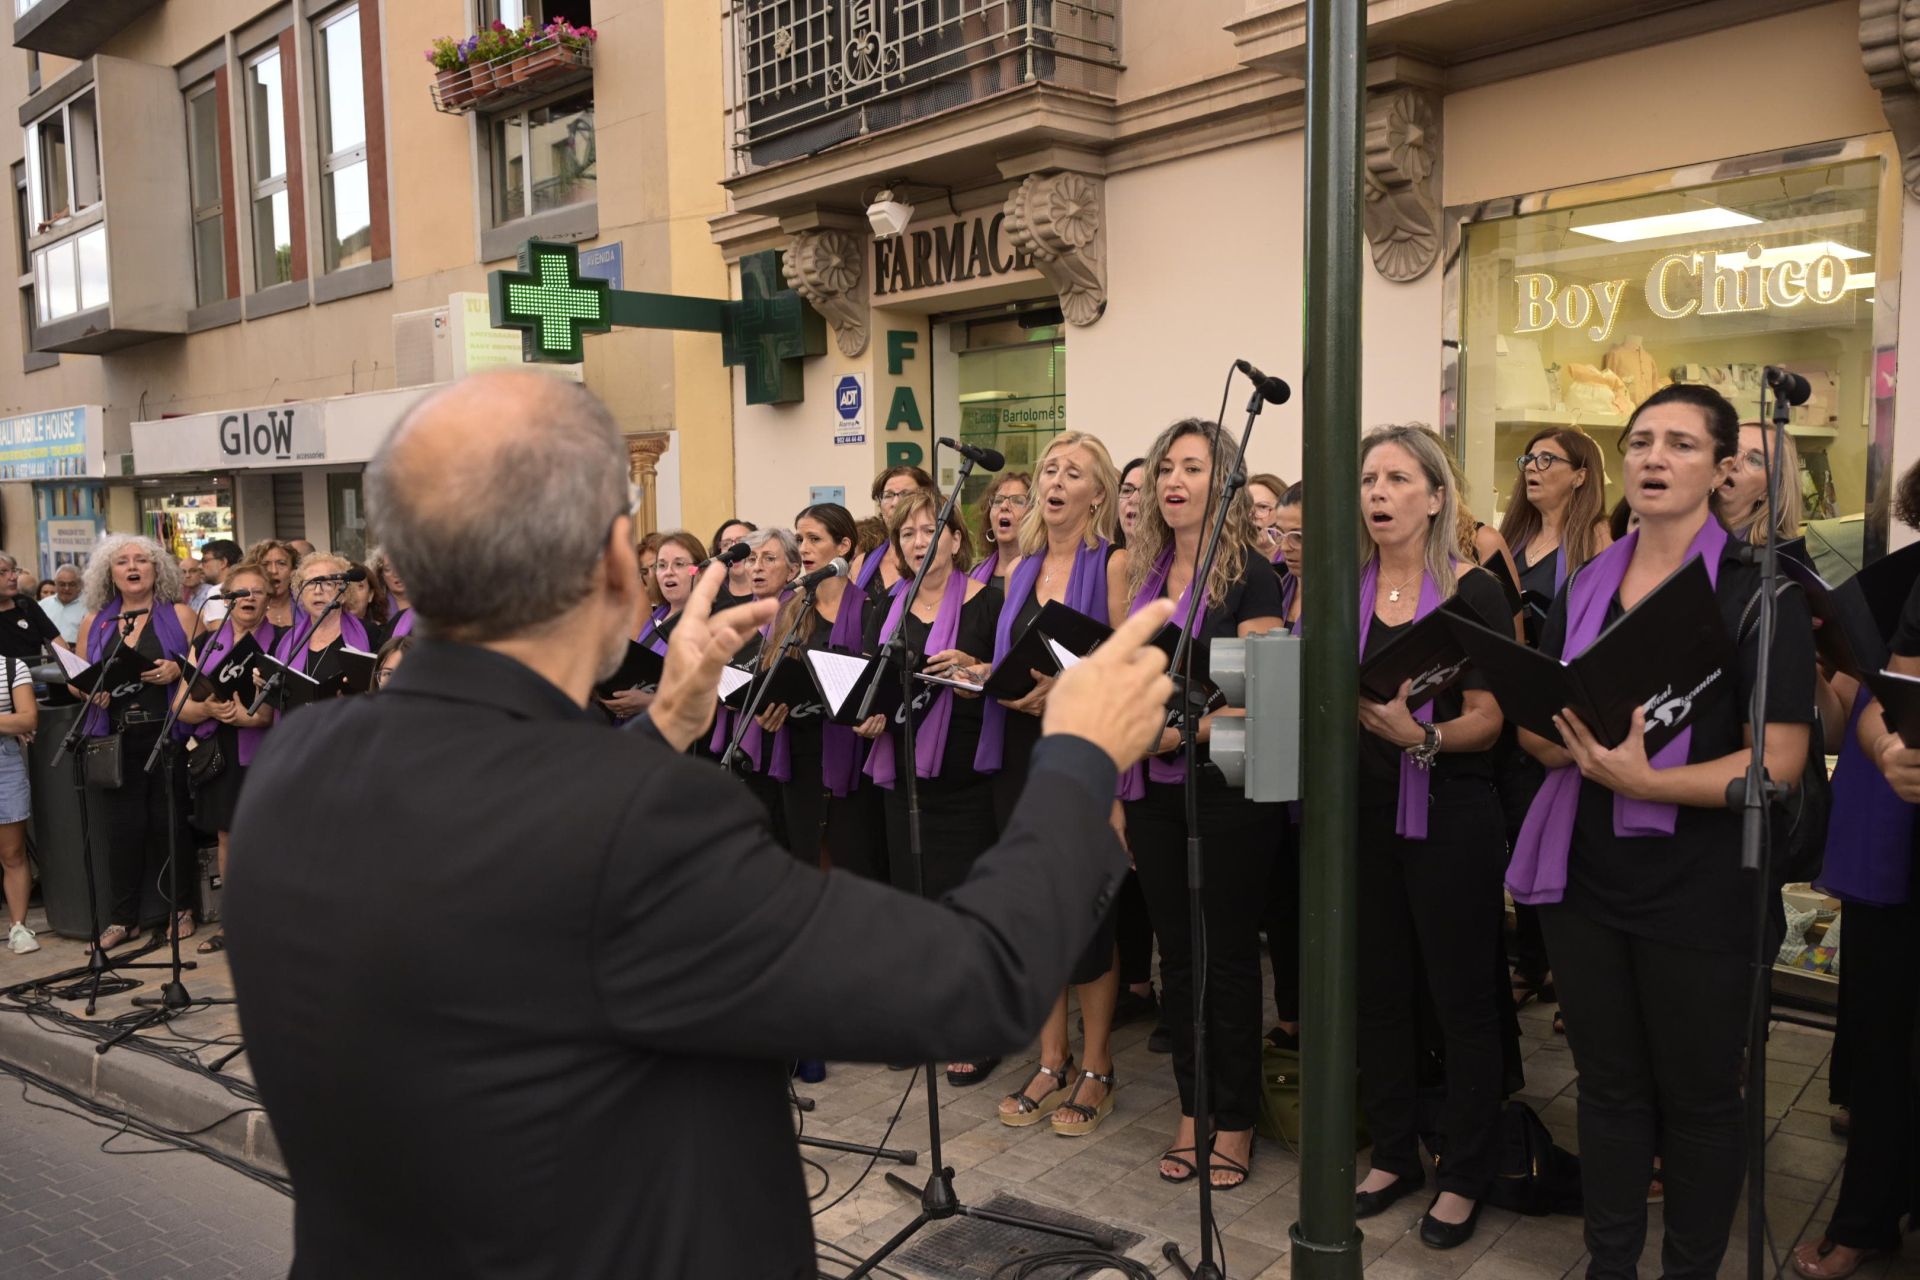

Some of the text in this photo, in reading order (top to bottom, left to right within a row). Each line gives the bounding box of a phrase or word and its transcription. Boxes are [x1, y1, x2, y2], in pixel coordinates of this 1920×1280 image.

[586, 250, 615, 265] AVENIDA
[1514, 241, 1851, 342] Boy Chico
[840, 390, 858, 407] ADT
[1002, 407, 1055, 423] Bartolomé
[15, 415, 45, 443] MOBILE
[45, 411, 76, 440] HOUSE
